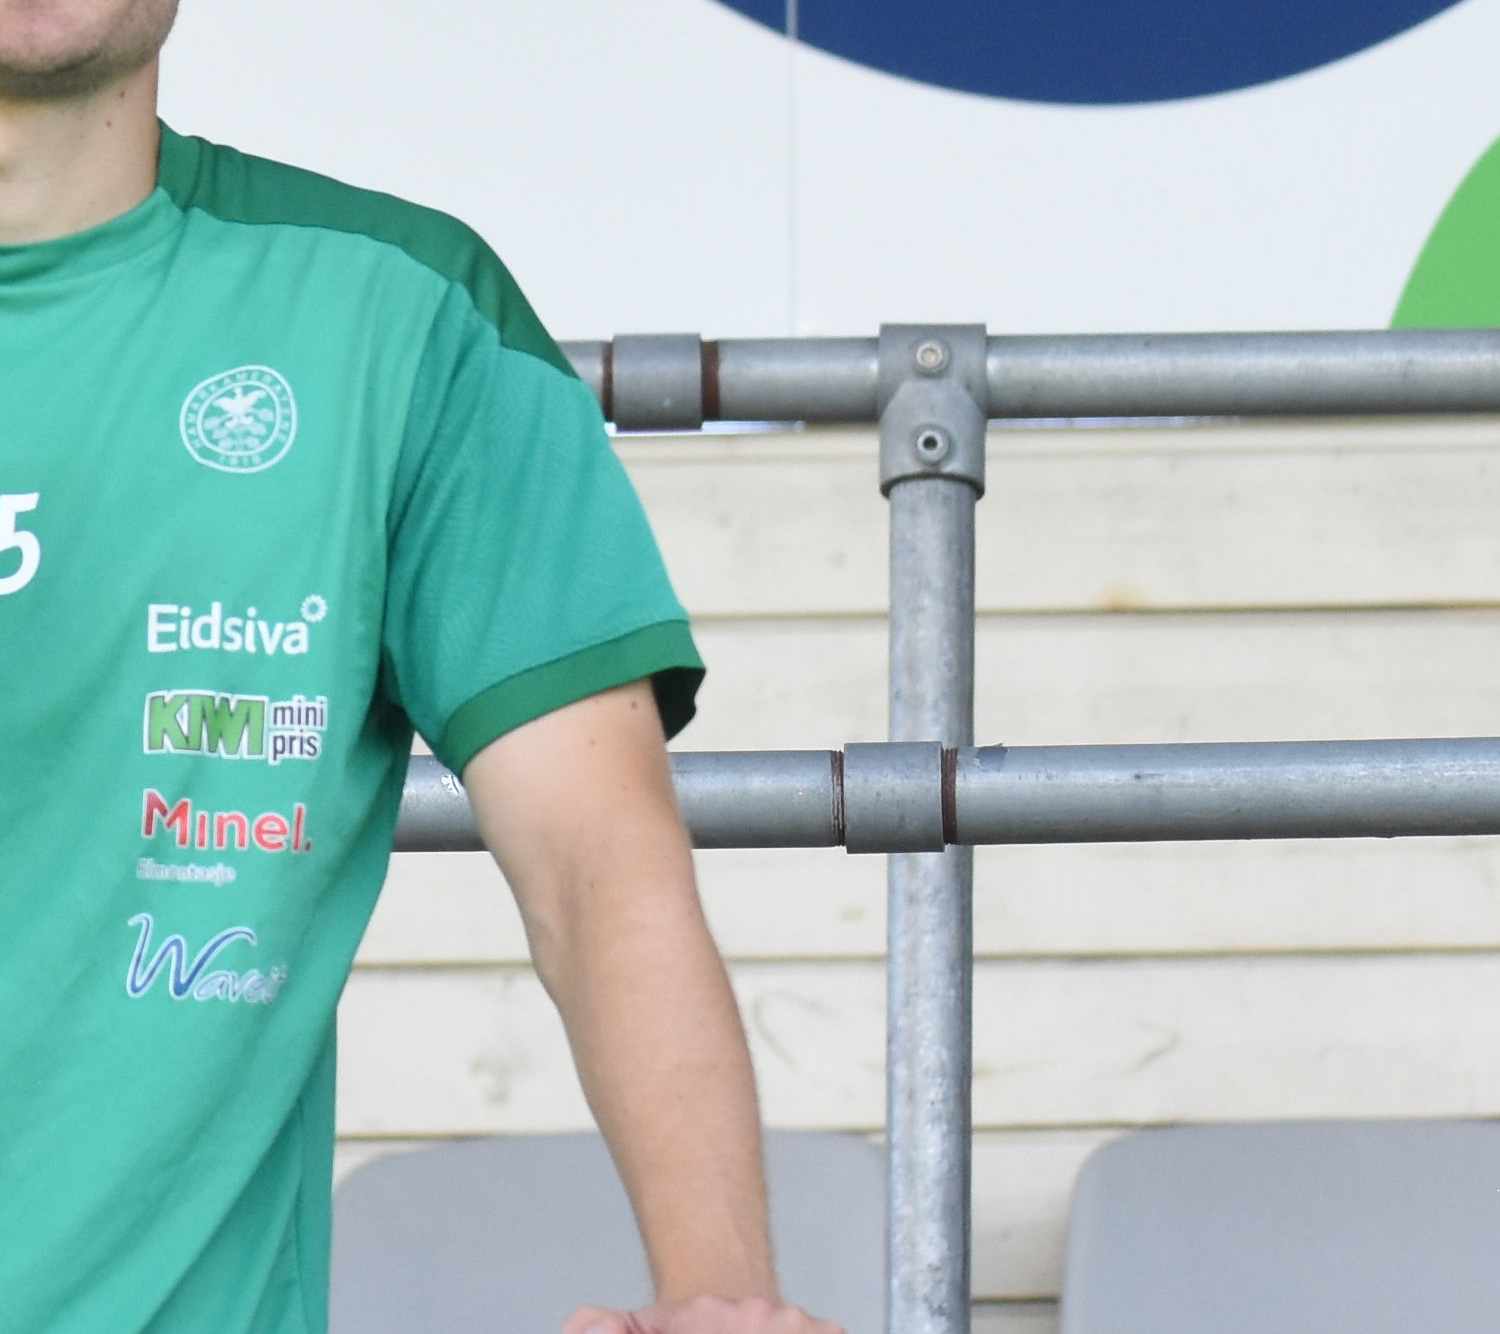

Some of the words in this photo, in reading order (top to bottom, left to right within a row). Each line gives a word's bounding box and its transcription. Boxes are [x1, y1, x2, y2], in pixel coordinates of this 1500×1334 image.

[148, 602, 309, 655] Eidsiva
[148, 693, 266, 757] KIWI
[272, 699, 325, 727] mini
[272, 728, 319, 761] pris
